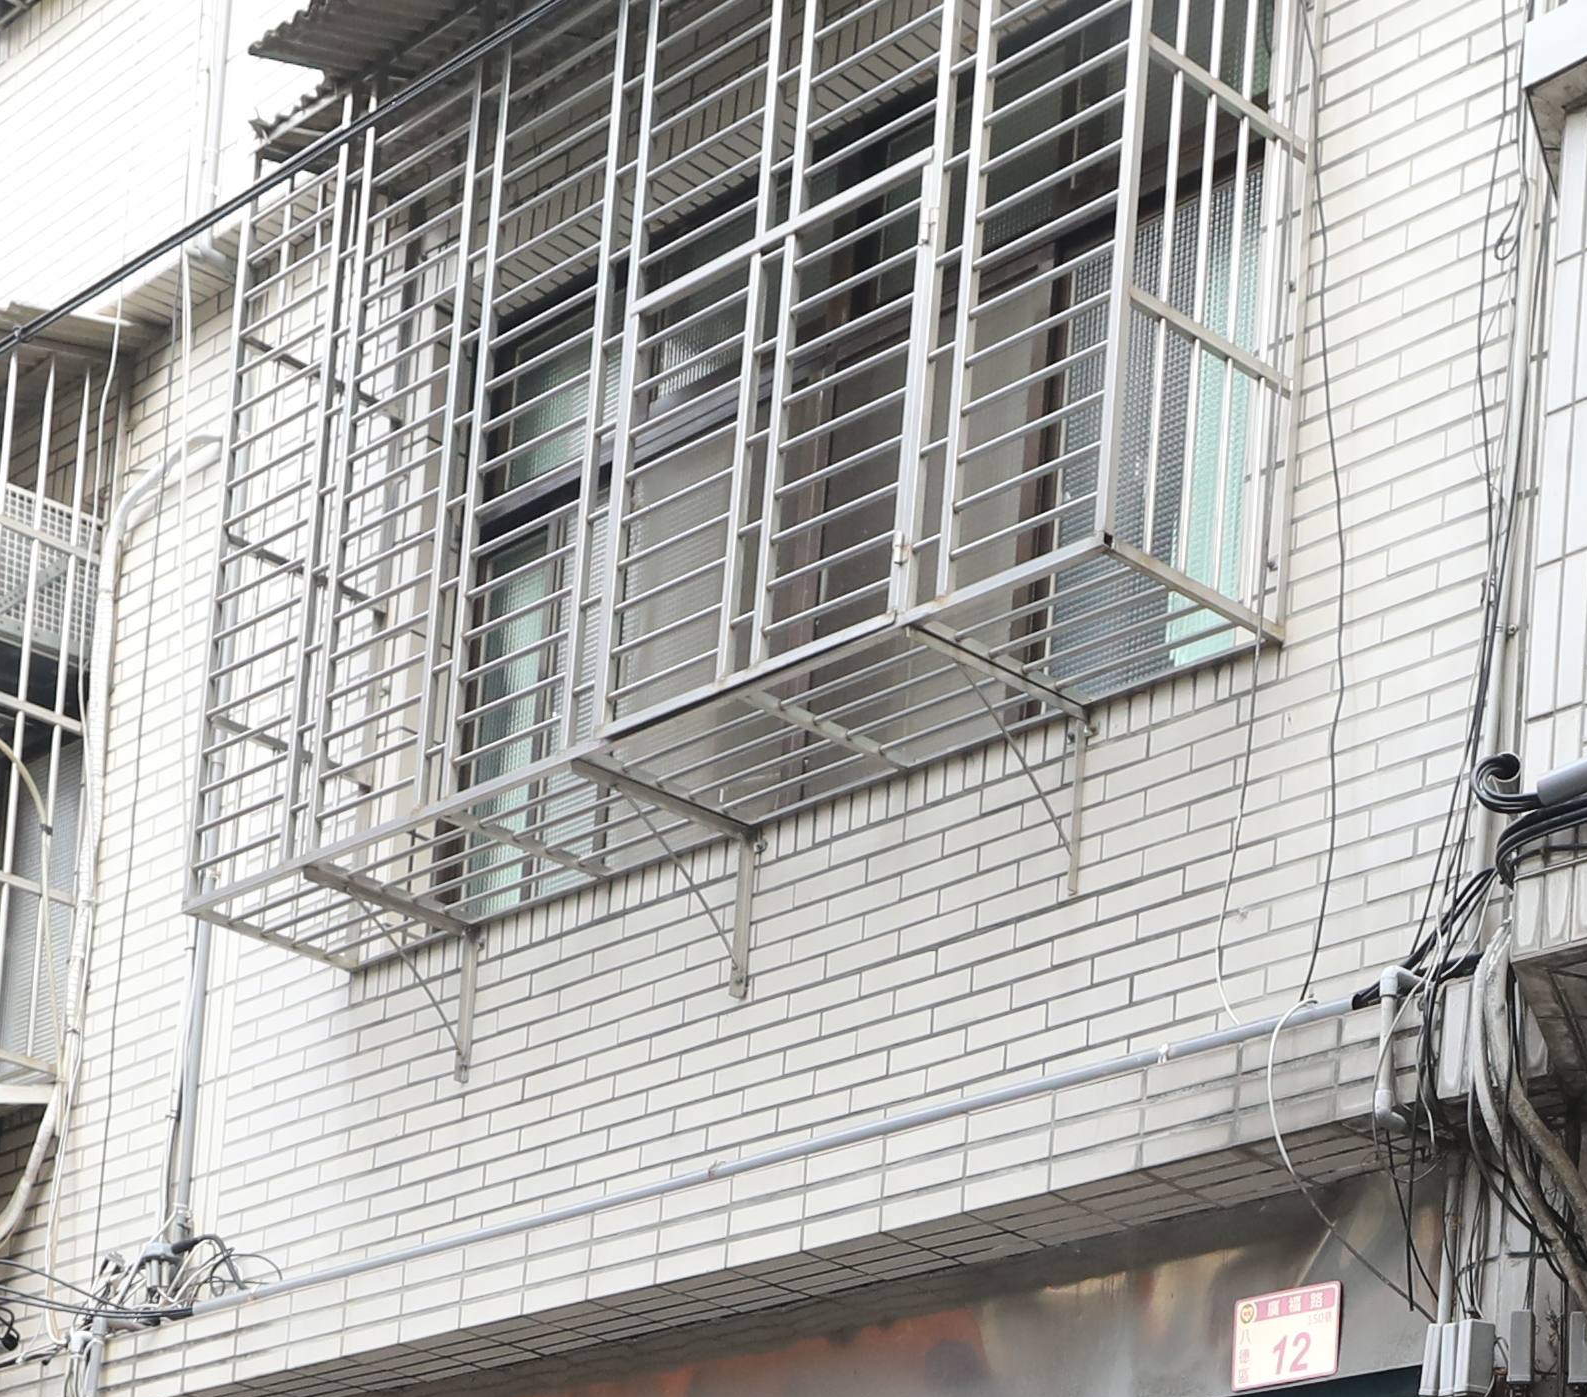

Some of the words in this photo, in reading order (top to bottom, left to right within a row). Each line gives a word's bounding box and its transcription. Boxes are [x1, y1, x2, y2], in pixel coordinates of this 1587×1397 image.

[1267, 1292, 1323, 1317] 廣福路
[1272, 1332, 1311, 1375] 12
